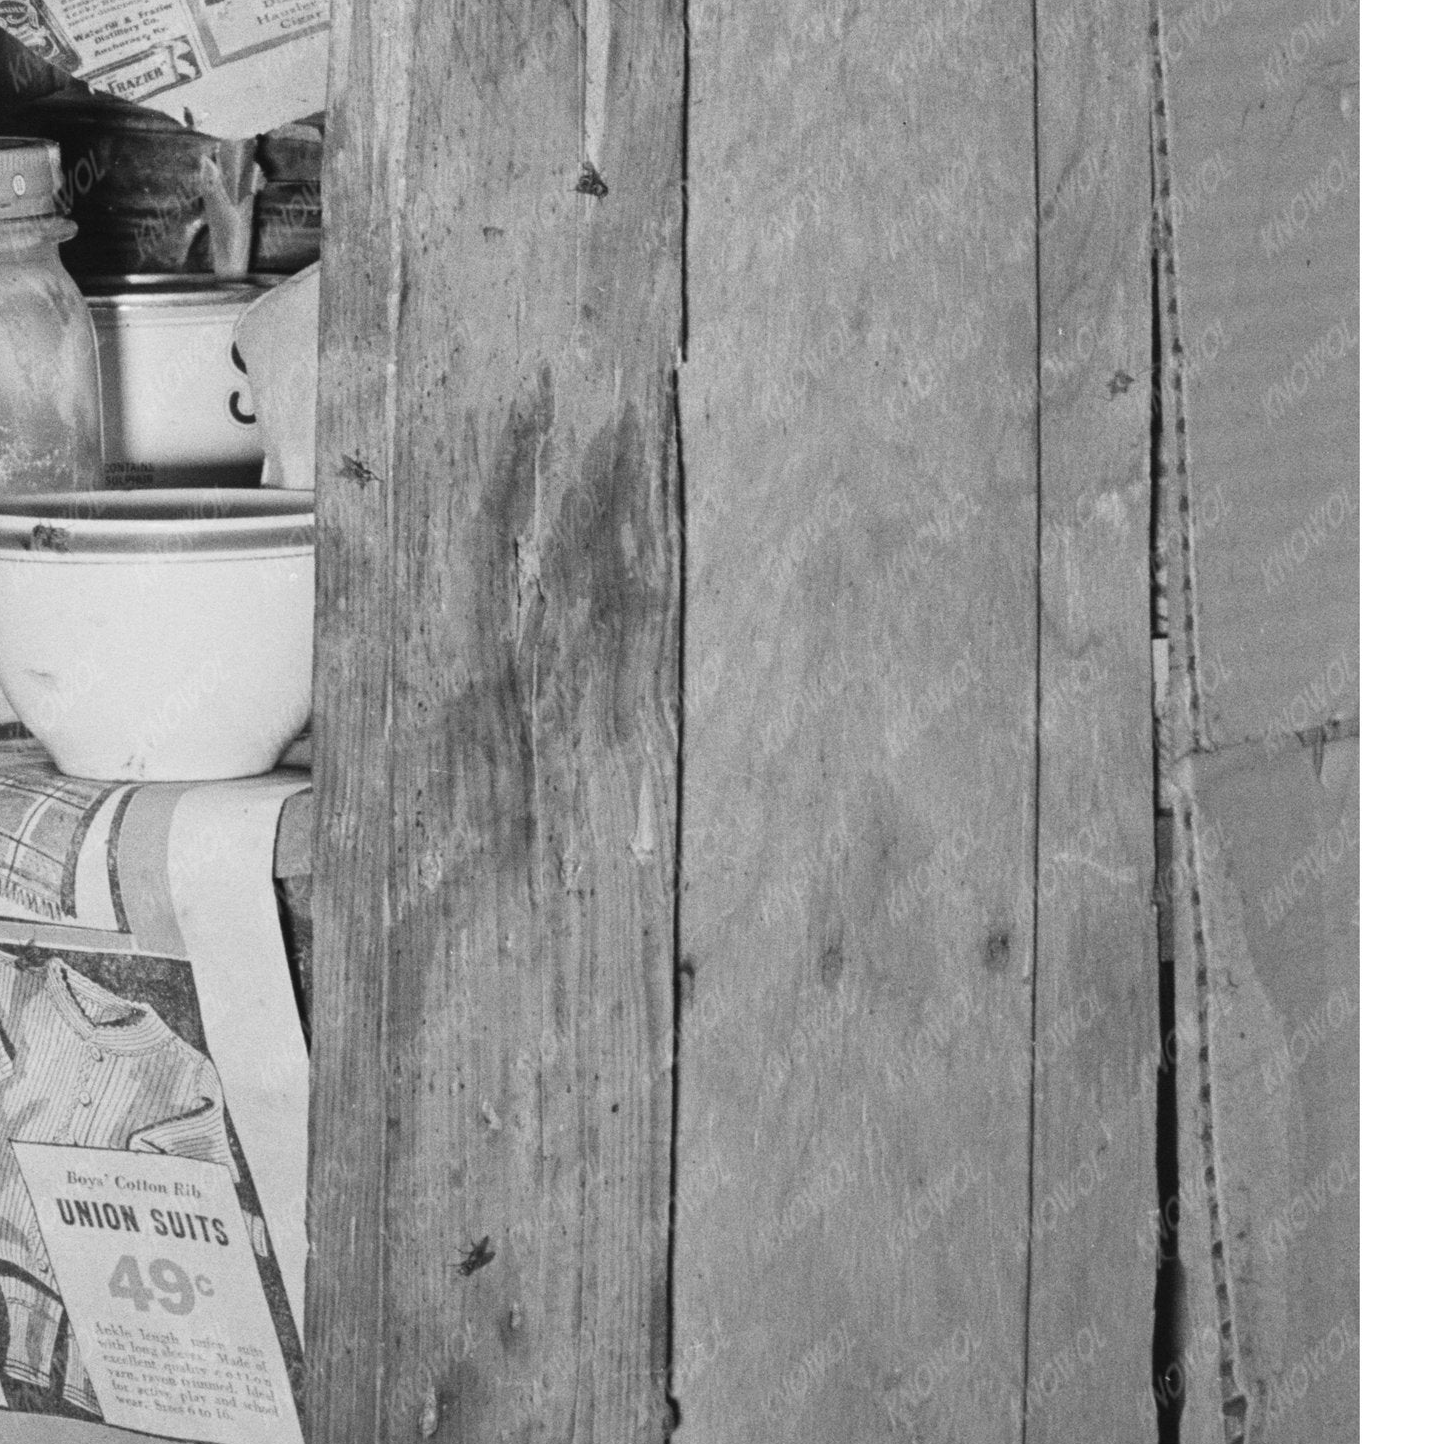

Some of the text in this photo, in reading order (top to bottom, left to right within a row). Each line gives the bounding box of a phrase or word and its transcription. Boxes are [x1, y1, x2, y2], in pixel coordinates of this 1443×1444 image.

[66, 1170, 202, 1199] Boys' Cotton Rib
[56, 1198, 230, 1247] UNION SUITS
